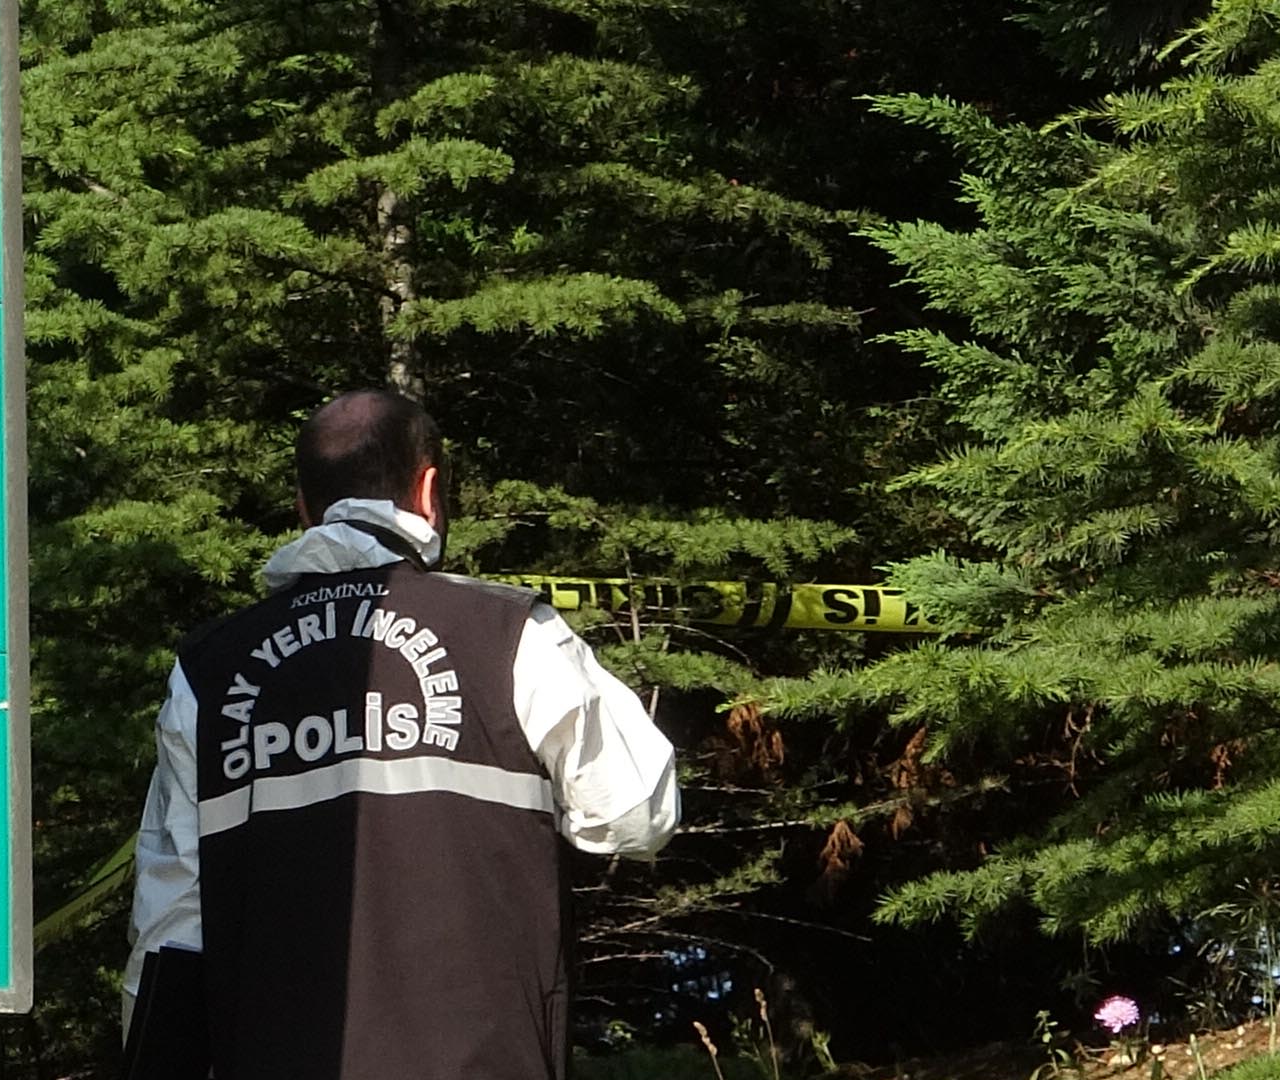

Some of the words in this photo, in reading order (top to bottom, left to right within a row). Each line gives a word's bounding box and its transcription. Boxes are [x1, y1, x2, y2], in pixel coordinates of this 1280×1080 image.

[821, 588, 938, 625] LİS
[221, 672, 261, 780] OLAY
[351, 600, 462, 751] İNCELEME
[253, 691, 419, 770] POLİS
